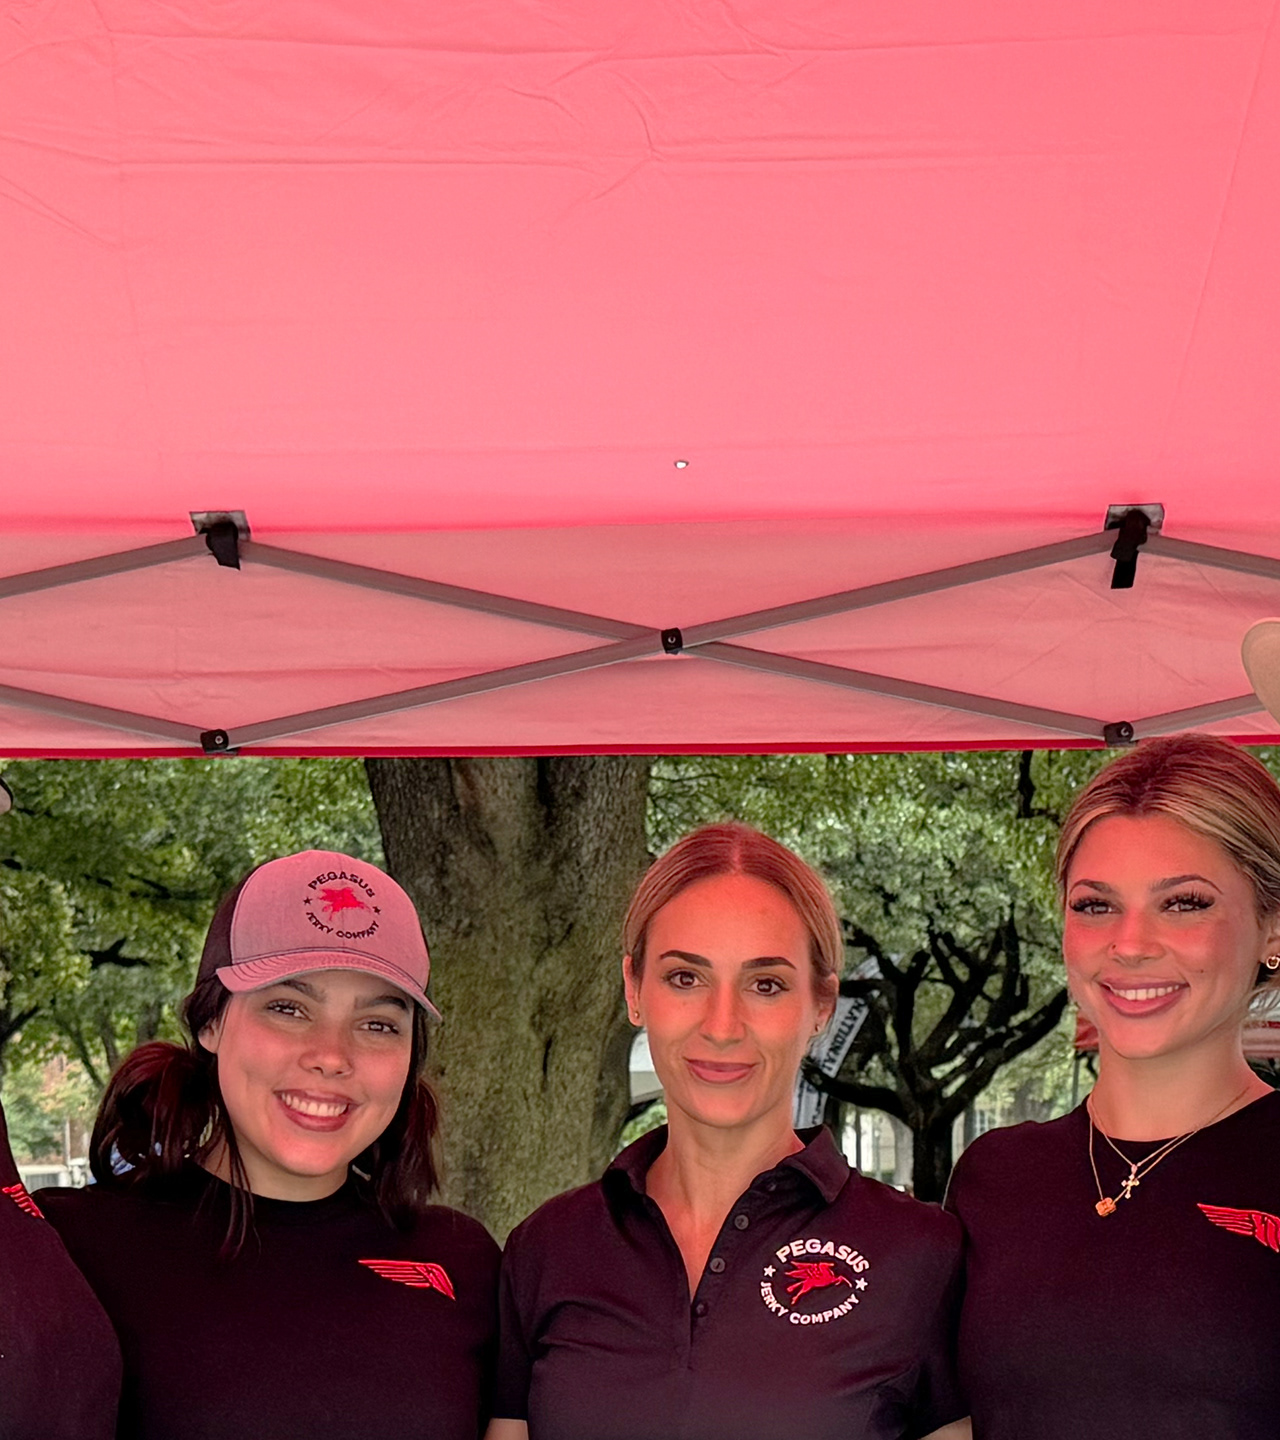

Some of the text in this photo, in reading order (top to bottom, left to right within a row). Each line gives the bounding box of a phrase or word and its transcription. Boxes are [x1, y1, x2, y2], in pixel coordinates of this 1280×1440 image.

[308, 871, 375, 898] PEGASUS
[336, 920, 379, 939] COMPANY
[776, 1239, 869, 1273] PEGASUS
[761, 1281, 859, 1325] JERKY COMPANY
